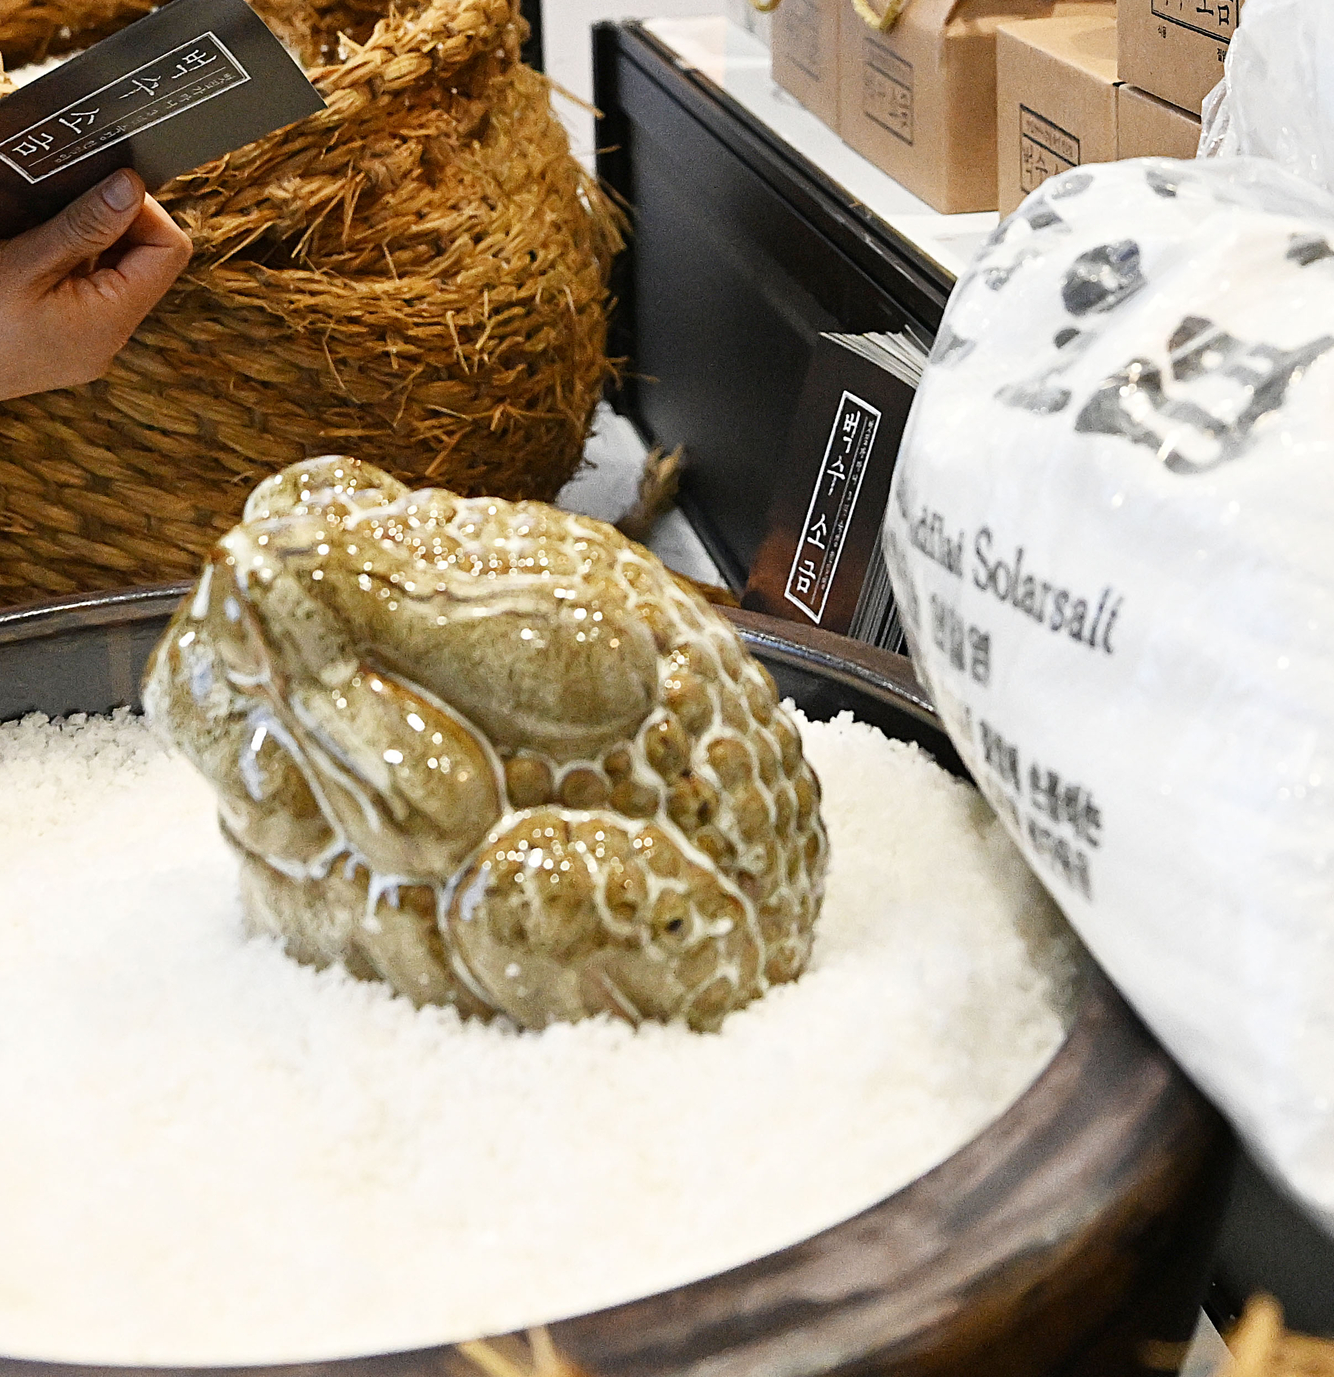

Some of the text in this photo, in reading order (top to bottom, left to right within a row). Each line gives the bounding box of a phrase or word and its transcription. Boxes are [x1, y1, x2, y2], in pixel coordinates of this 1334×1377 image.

[11, 48, 218, 157] 벅수 소금
[794, 409, 862, 594] 벅수 소금
